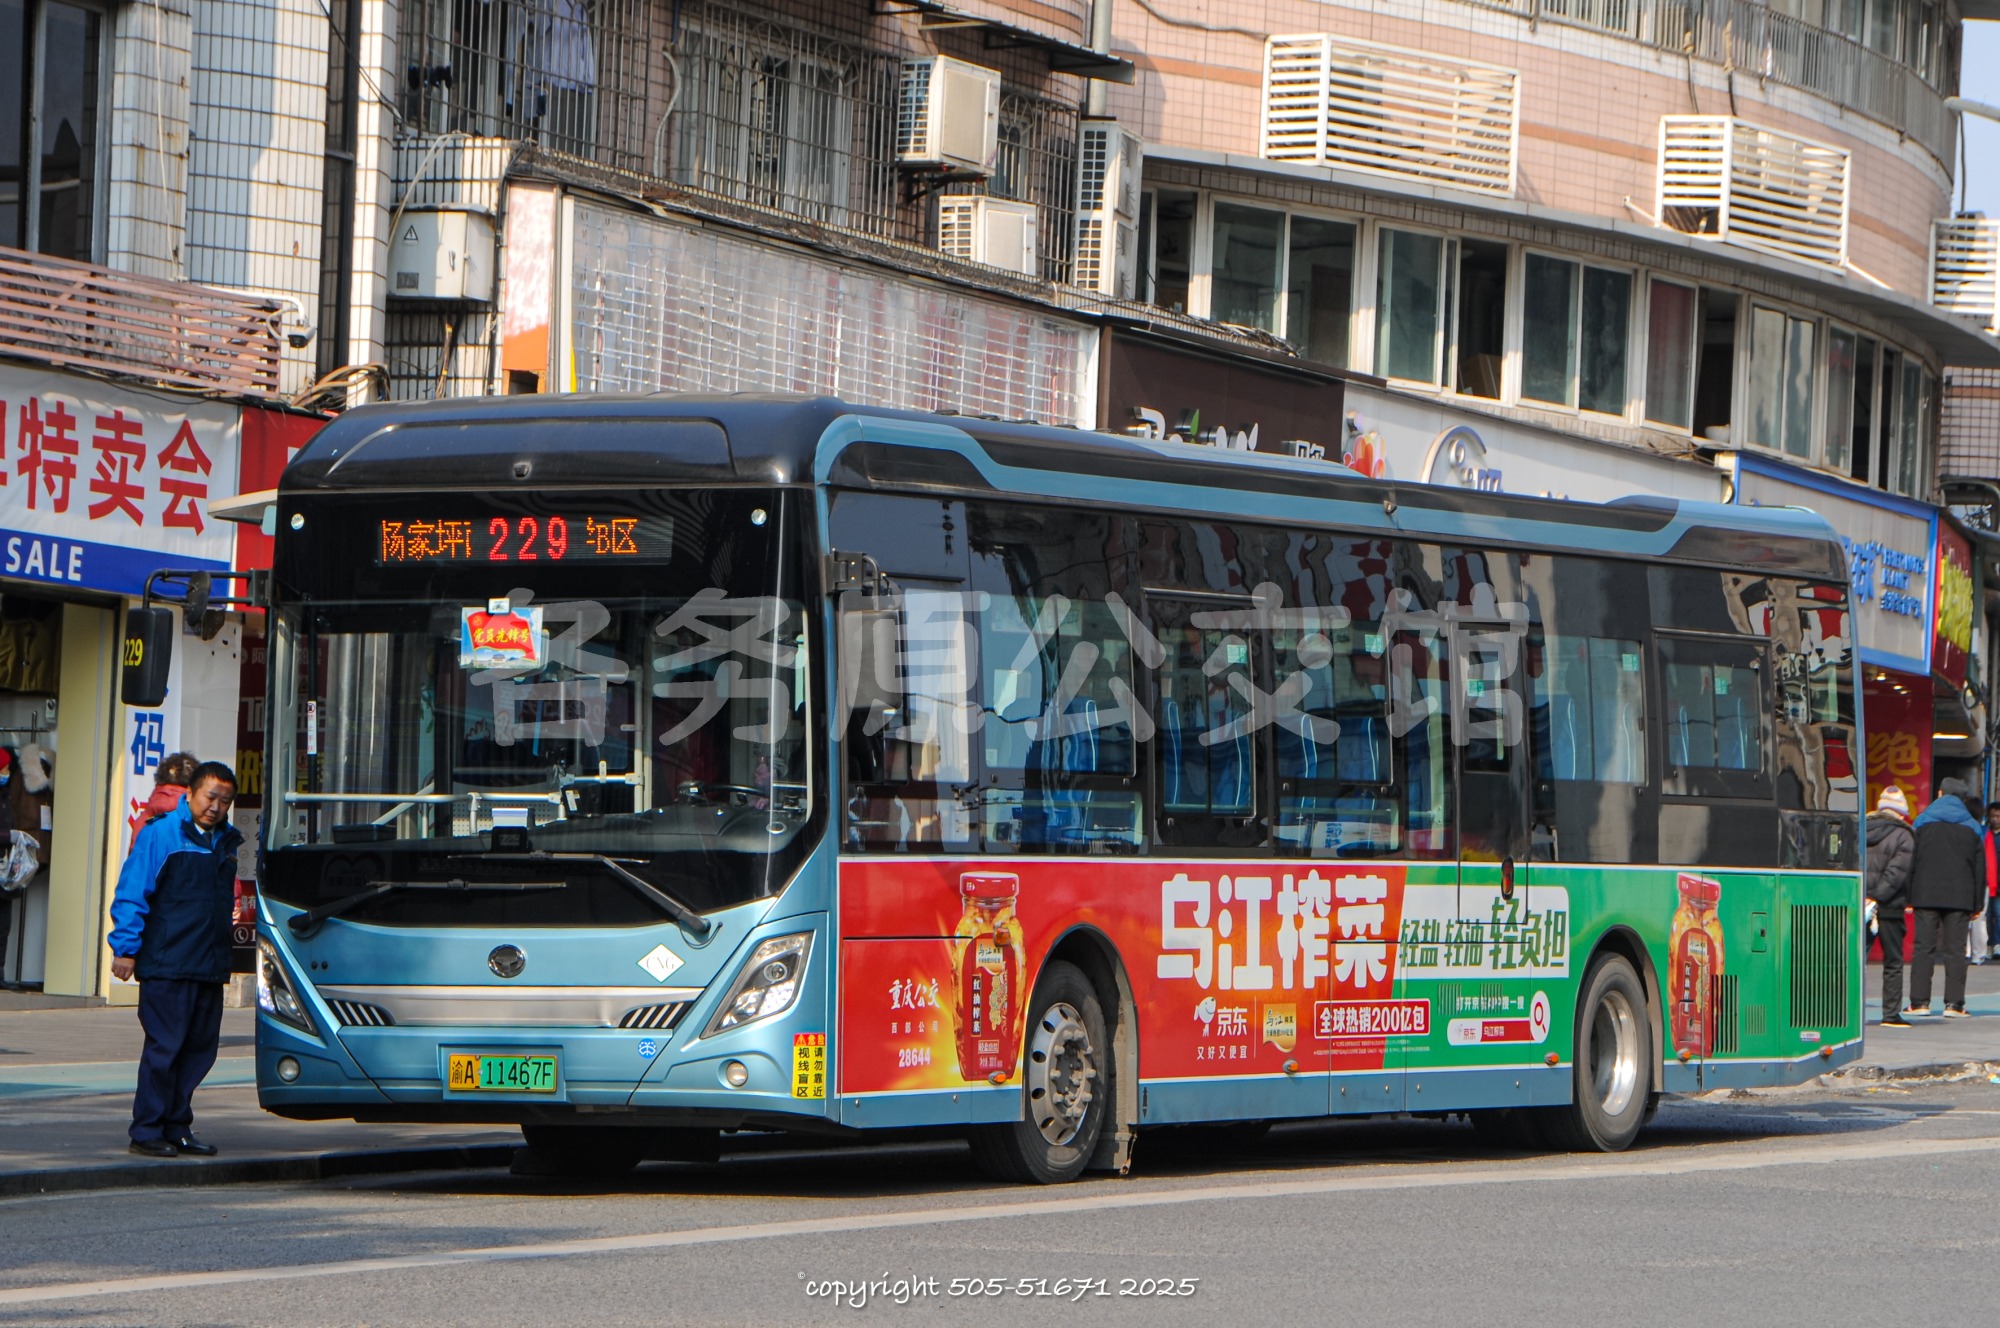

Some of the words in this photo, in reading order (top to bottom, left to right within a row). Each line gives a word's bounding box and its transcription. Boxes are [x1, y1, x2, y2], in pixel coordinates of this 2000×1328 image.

[0, 397, 212, 536] 特卖会
[382, 519, 471, 561] 杨家坪
[489, 517, 567, 560] 229
[6, 537, 83, 582] SALE
[473, 627, 530, 643] 党员先锋号
[124, 638, 143, 666] 229
[1157, 868, 1388, 990] 乌江榨菜
[646, 956, 675, 969] CNG
[889, 978, 940, 1010] 重庆公交
[1217, 1006, 1248, 1036] 京东
[1319, 1006, 1425, 1034] 全球热销200亿包
[1463, 1028, 1476, 1040] 京东
[898, 1047, 931, 1068] 28644
[1196, 1045, 1248, 1060] 又好又便宜
